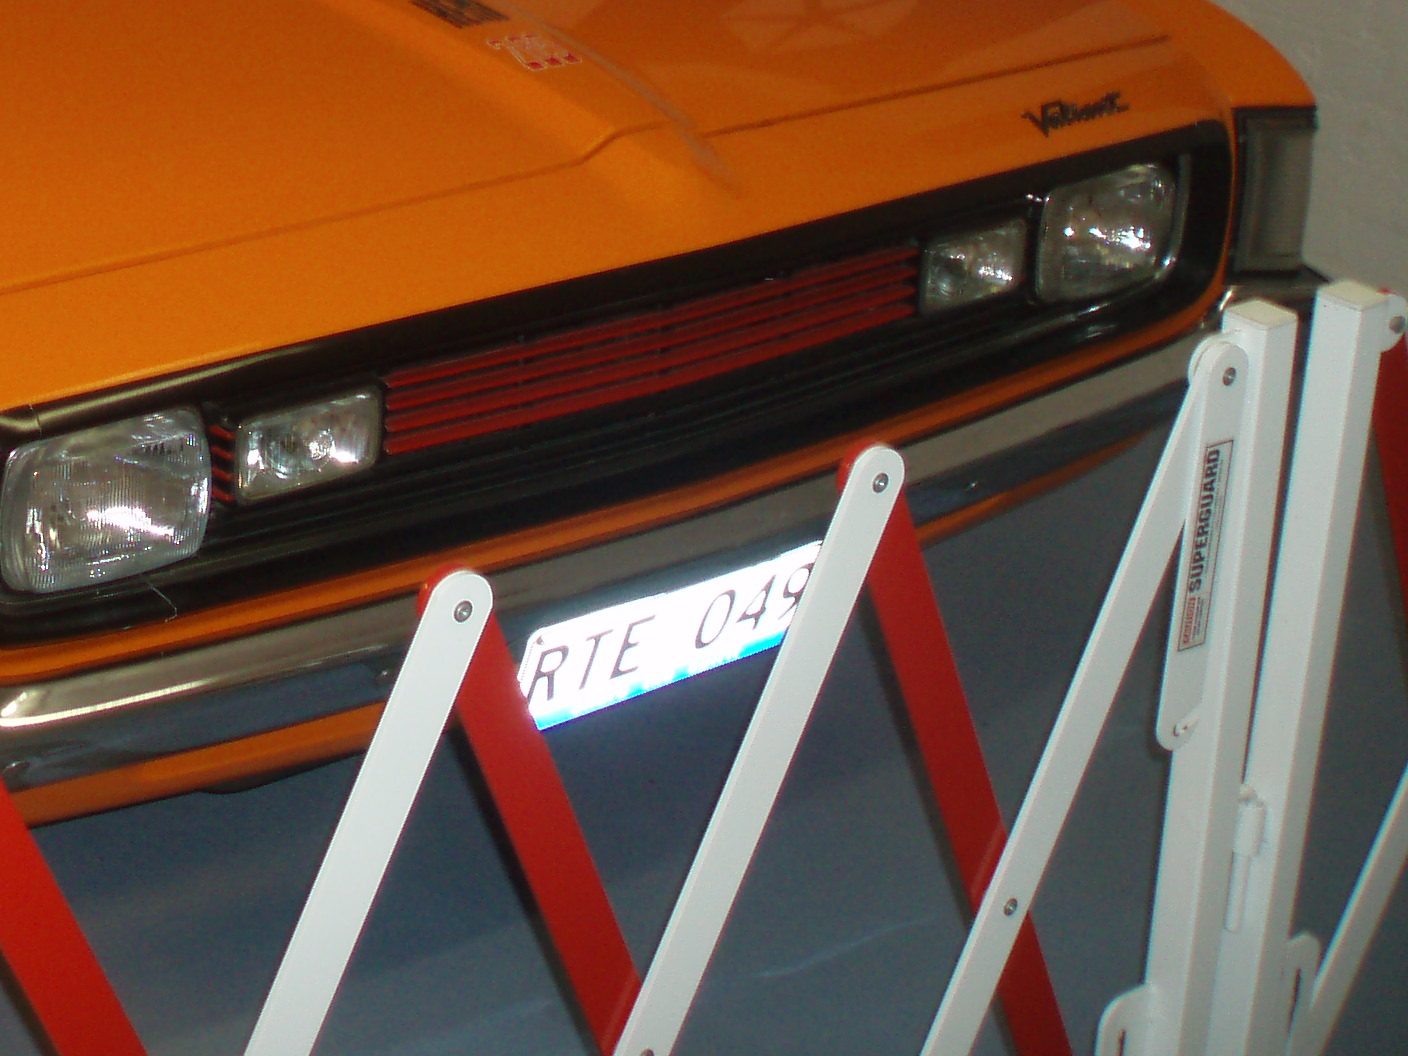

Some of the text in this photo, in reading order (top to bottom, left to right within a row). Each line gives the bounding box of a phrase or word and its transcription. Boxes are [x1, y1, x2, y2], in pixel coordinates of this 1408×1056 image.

[1187, 447, 1222, 594] SUPERGUARD
[526, 561, 815, 703] RTE 049
